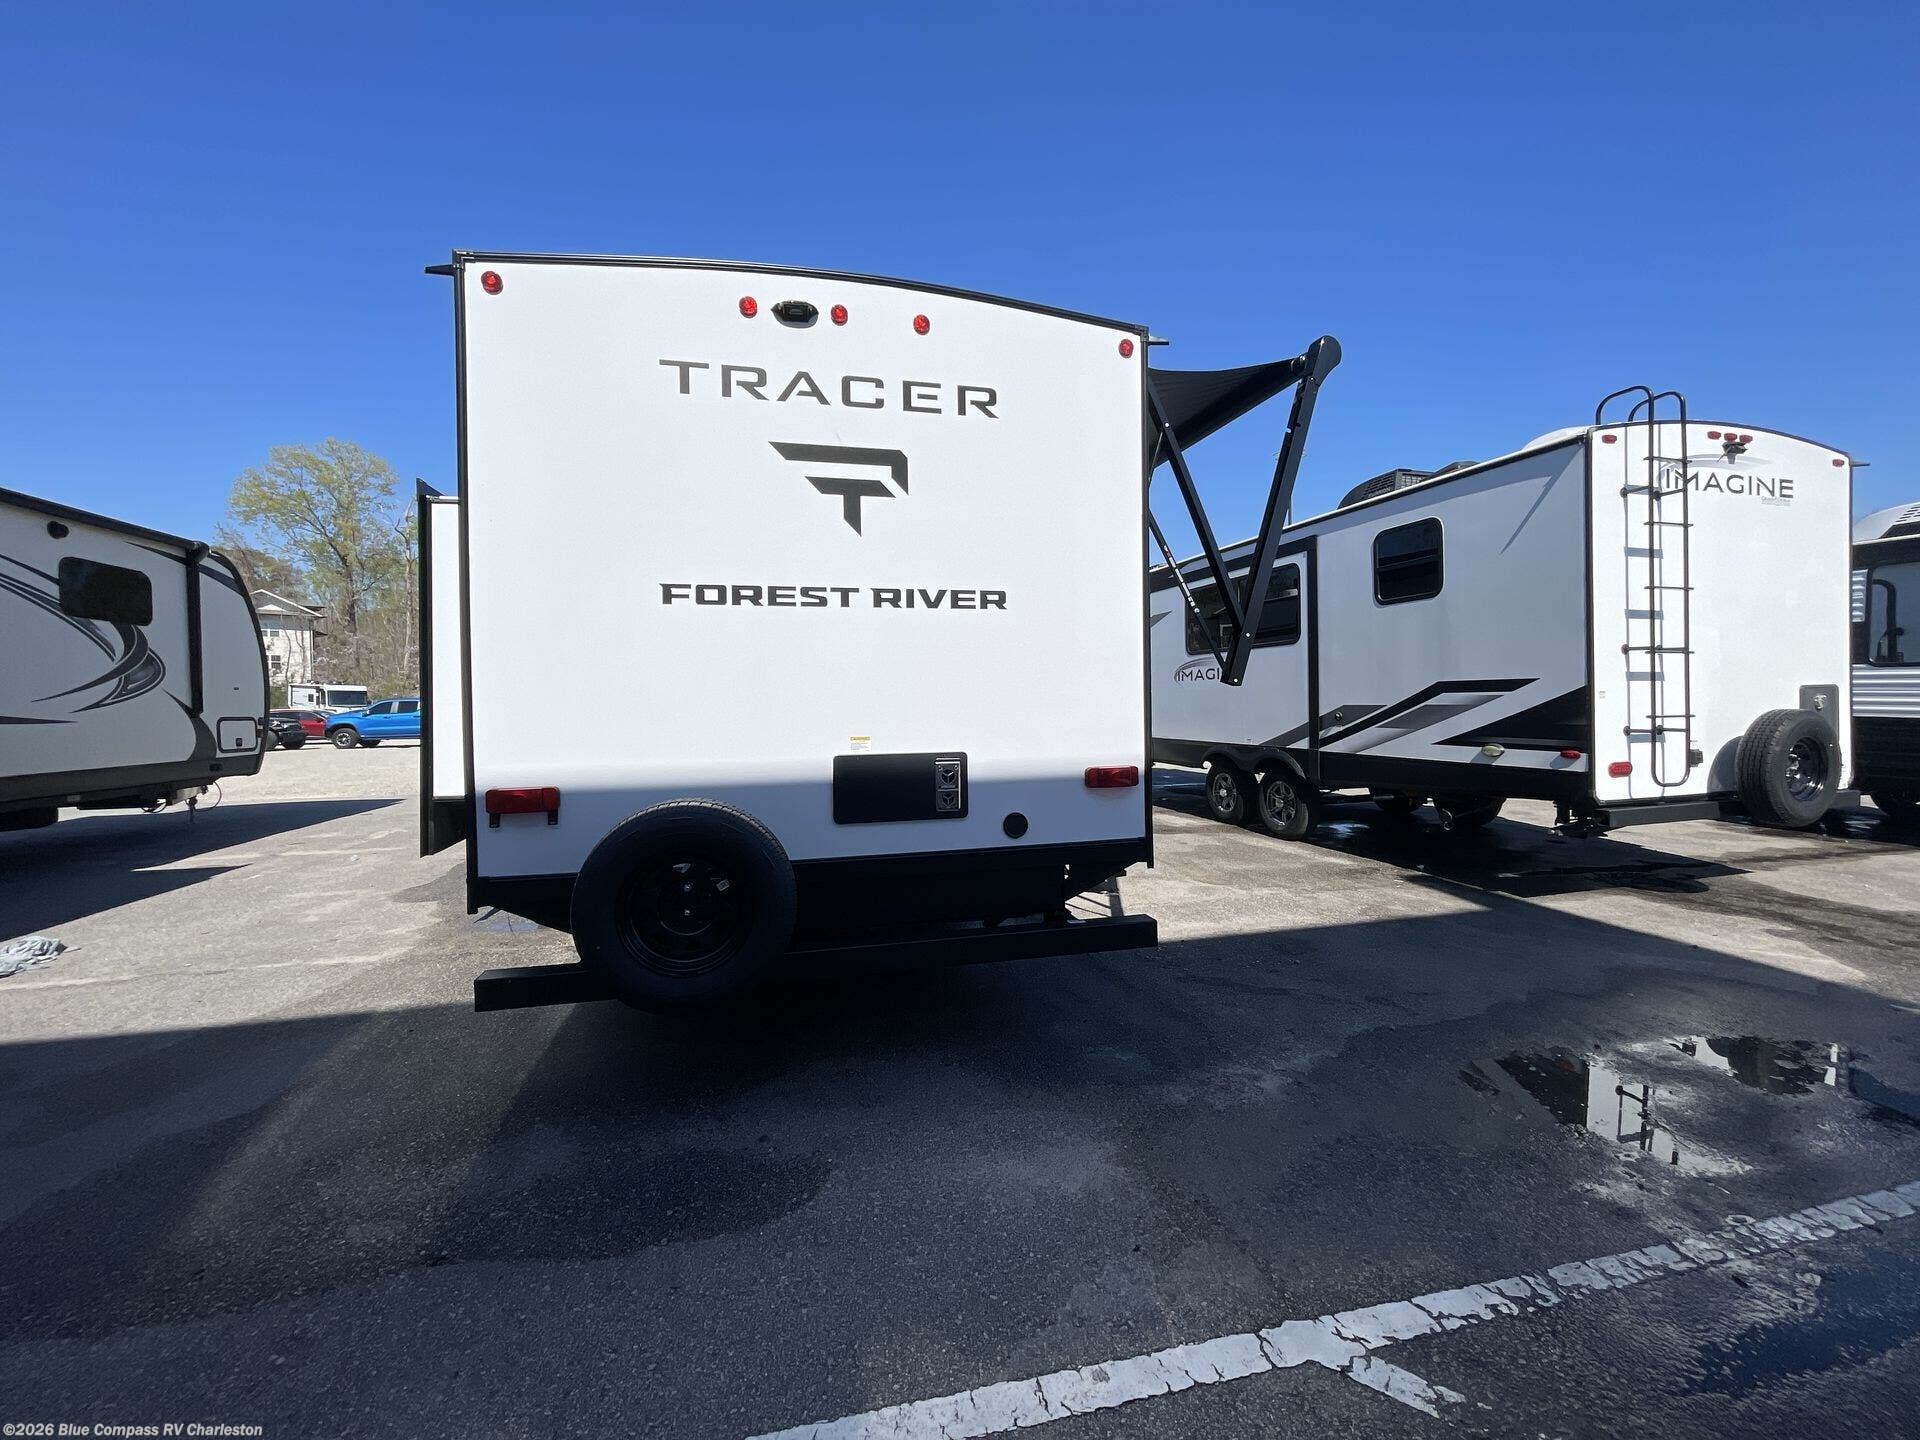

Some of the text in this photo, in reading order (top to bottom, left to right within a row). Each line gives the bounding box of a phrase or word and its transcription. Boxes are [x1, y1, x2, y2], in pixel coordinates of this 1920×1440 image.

[659, 360, 998, 418] TRACER
[1666, 468, 1794, 498] IMAGINE
[660, 584, 1007, 609] FOREST RIVER
[1178, 668, 1219, 681] IMAGI
